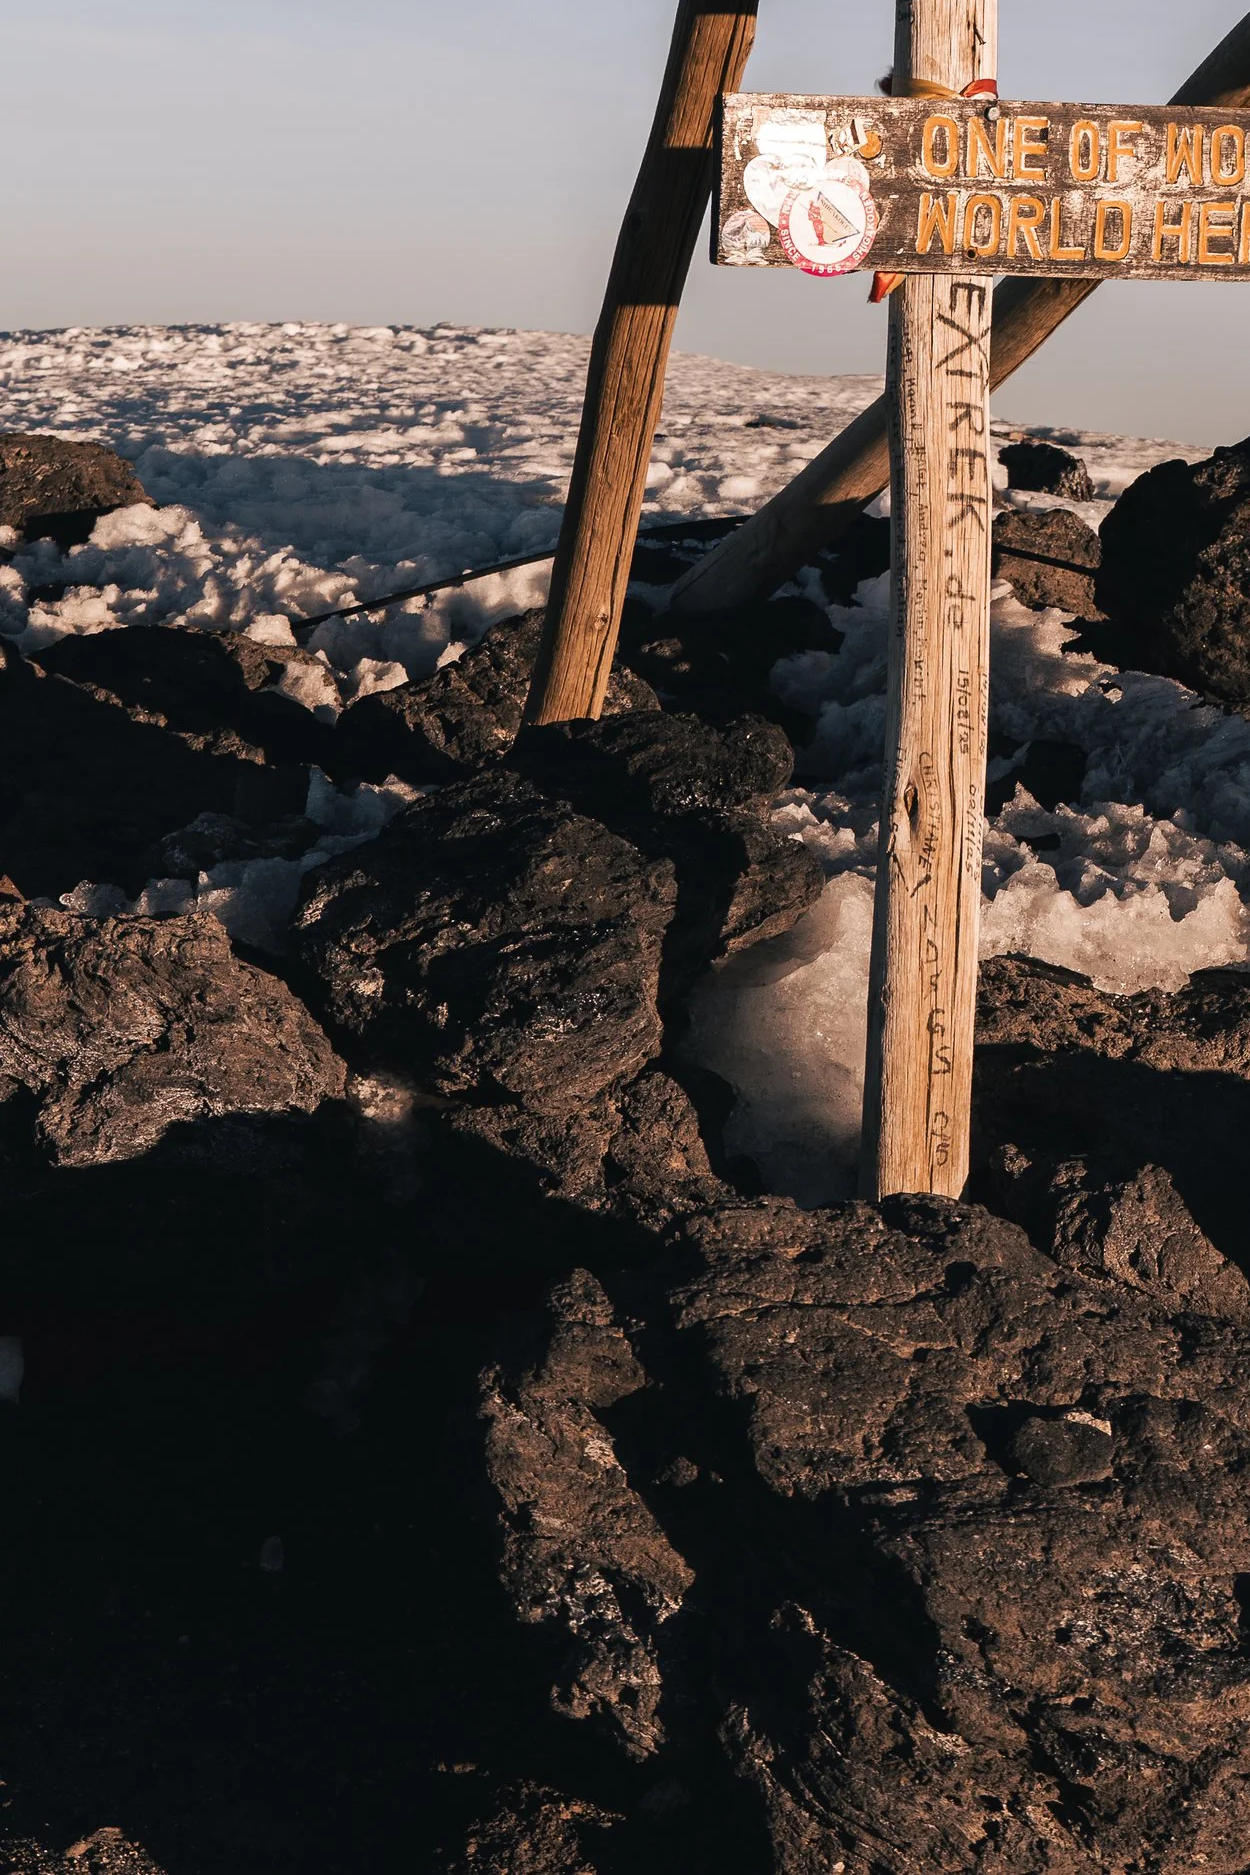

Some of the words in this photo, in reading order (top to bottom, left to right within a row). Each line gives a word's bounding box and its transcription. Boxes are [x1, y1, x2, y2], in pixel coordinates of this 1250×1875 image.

[922, 114, 1050, 182] ONE
[1071, 120, 1144, 183] OF
[780, 229, 801, 261] SINCE
[853, 191, 876, 261] SHIGAKOGEN
[916, 192, 1132, 262] WORLD
